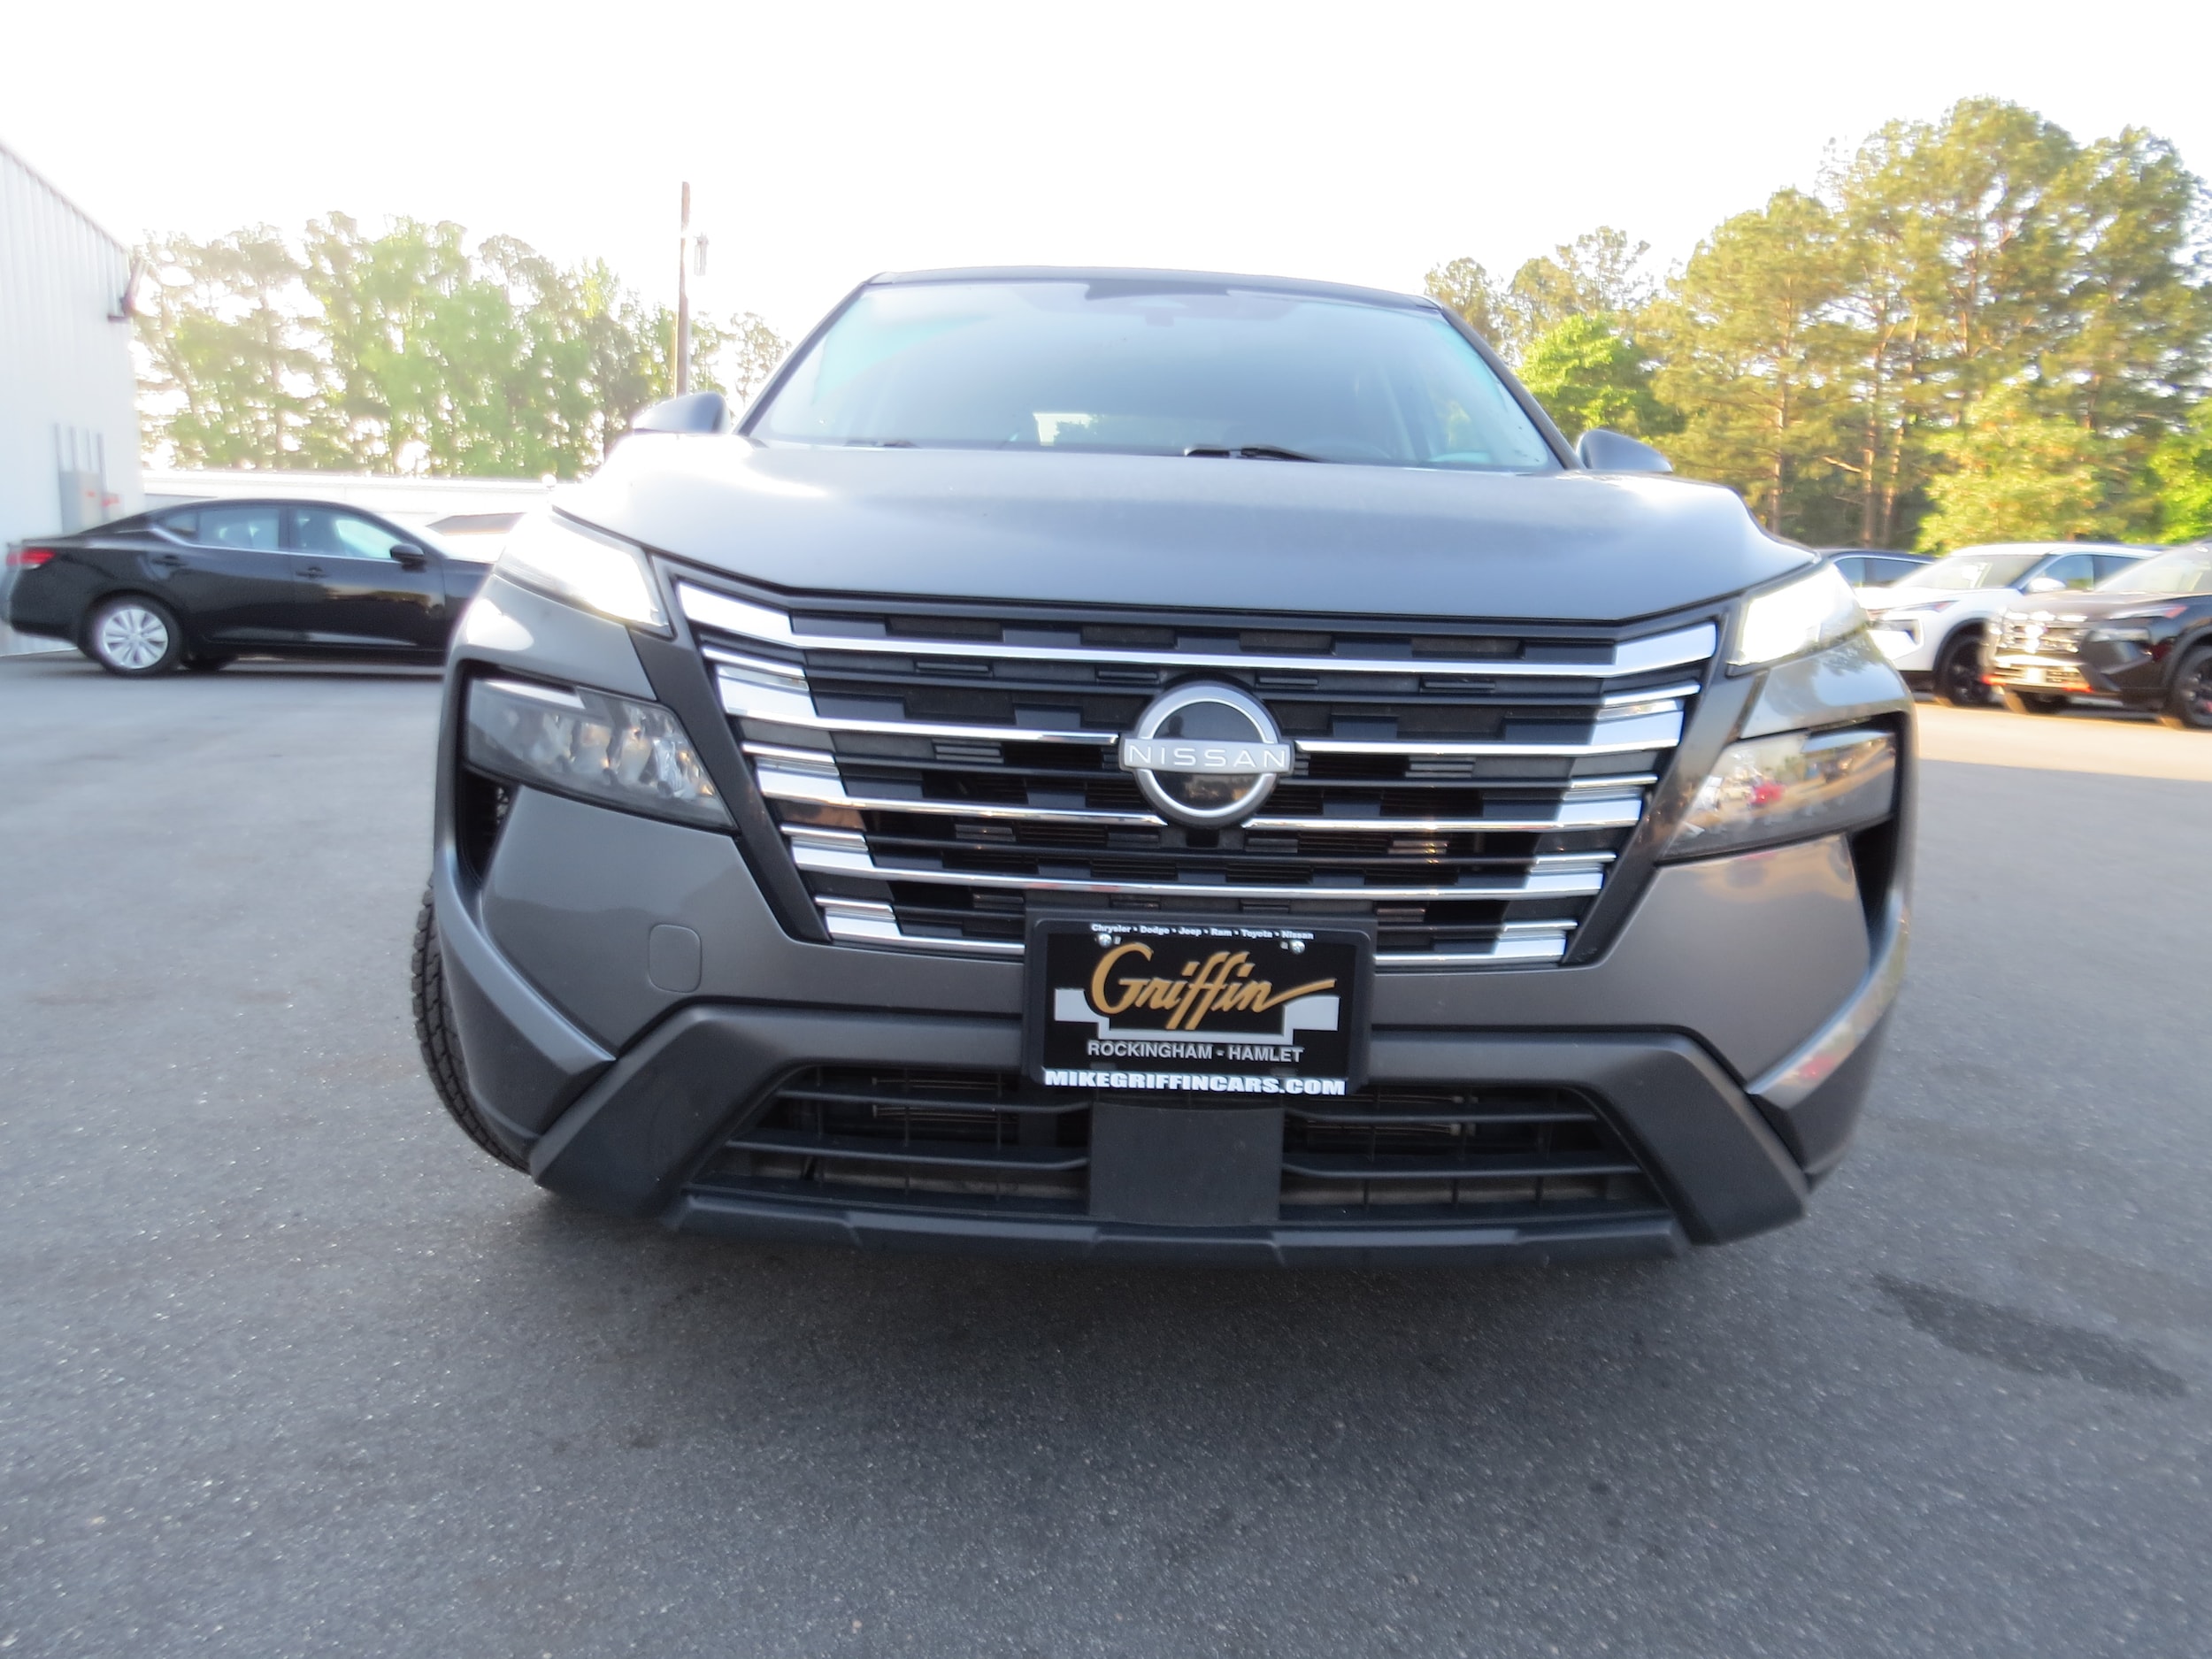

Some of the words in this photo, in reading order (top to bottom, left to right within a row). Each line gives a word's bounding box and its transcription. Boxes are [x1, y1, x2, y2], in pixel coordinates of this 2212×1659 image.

[1129, 745, 1285, 768] NISSAN
[1091, 924, 1132, 933] Chrysler
[1140, 925, 1170, 935] Dodge
[1178, 926, 1202, 936] Jeep
[1210, 927, 1233, 936] Ram
[1240, 928, 1273, 939] Toyota
[1280, 930, 1314, 940] Nissan
[1091, 942, 1337, 1030] Griffin
[1087, 1040, 1212, 1060] ROCKINGHAM
[1228, 1045, 1305, 1063] HAMLET
[1044, 1071, 1346, 1095] MIKEGRIFFINCARS.COM
